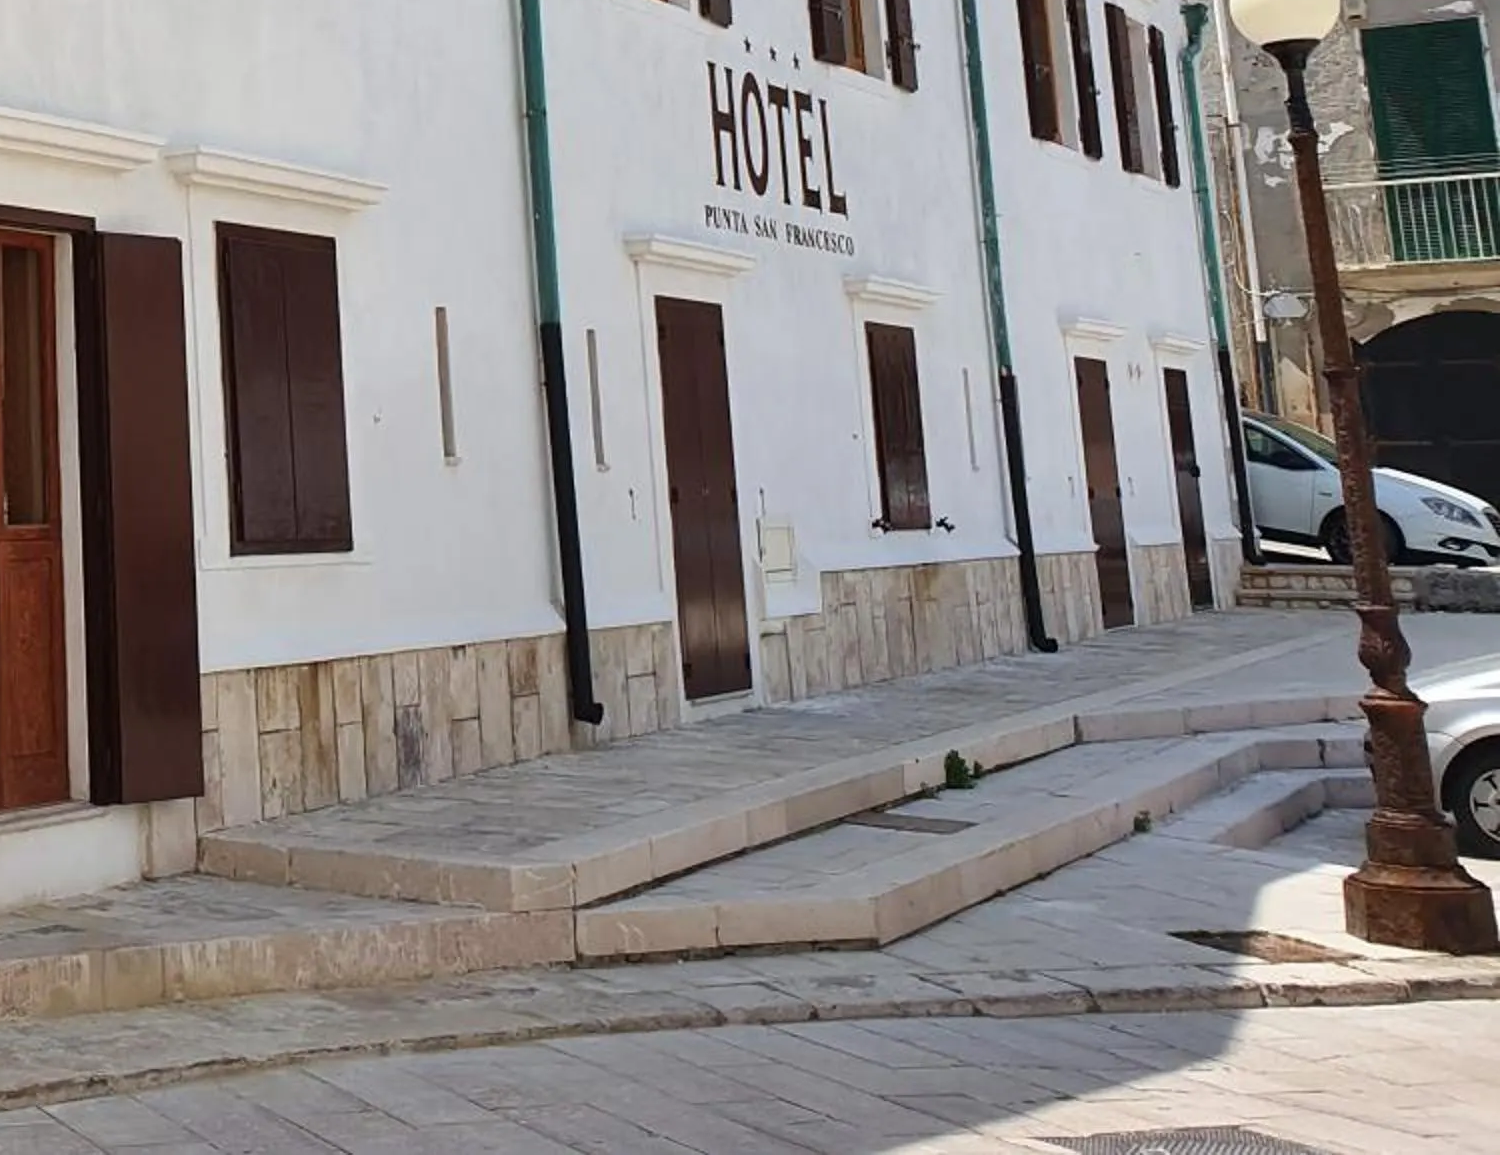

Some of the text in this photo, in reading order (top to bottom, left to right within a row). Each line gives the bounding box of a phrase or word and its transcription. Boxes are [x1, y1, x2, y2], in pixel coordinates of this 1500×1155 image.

[707, 60, 848, 220] HOTEL
[704, 205, 854, 256] PUNTA SAN FRANCESCO
